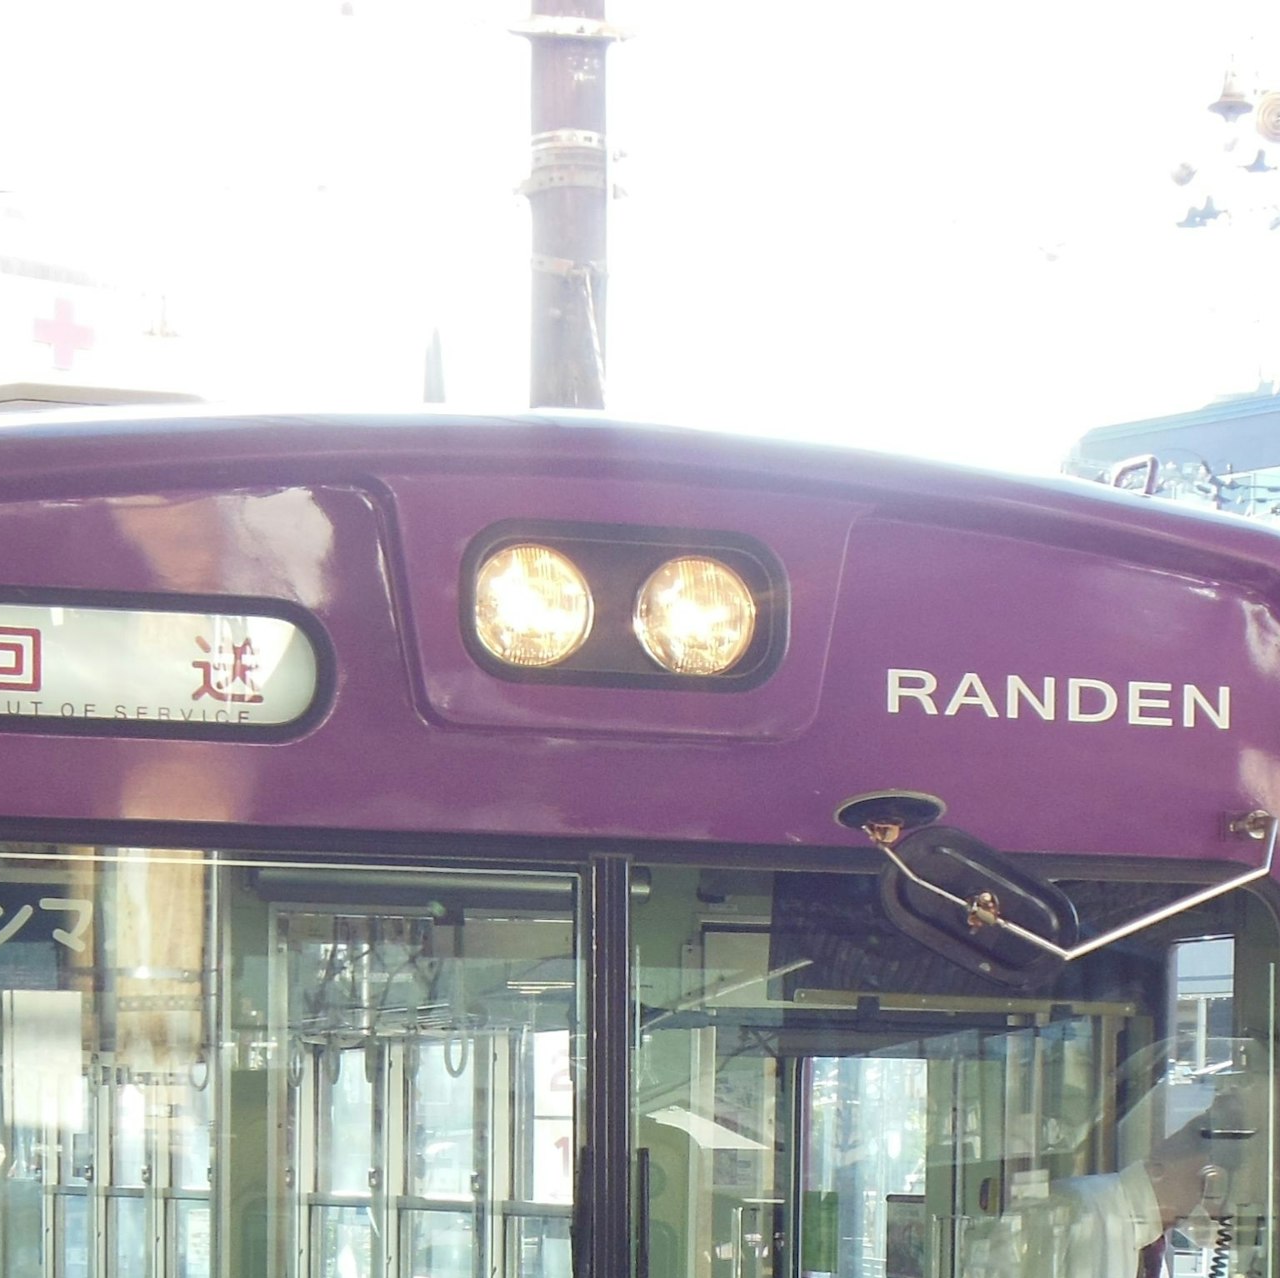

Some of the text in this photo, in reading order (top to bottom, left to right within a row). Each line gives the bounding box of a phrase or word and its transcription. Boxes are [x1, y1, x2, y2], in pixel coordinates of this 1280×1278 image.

[60, 702, 96, 718] OF
[114, 704, 250, 724] SERVICE
[887, 668, 1230, 729] RANDEN
